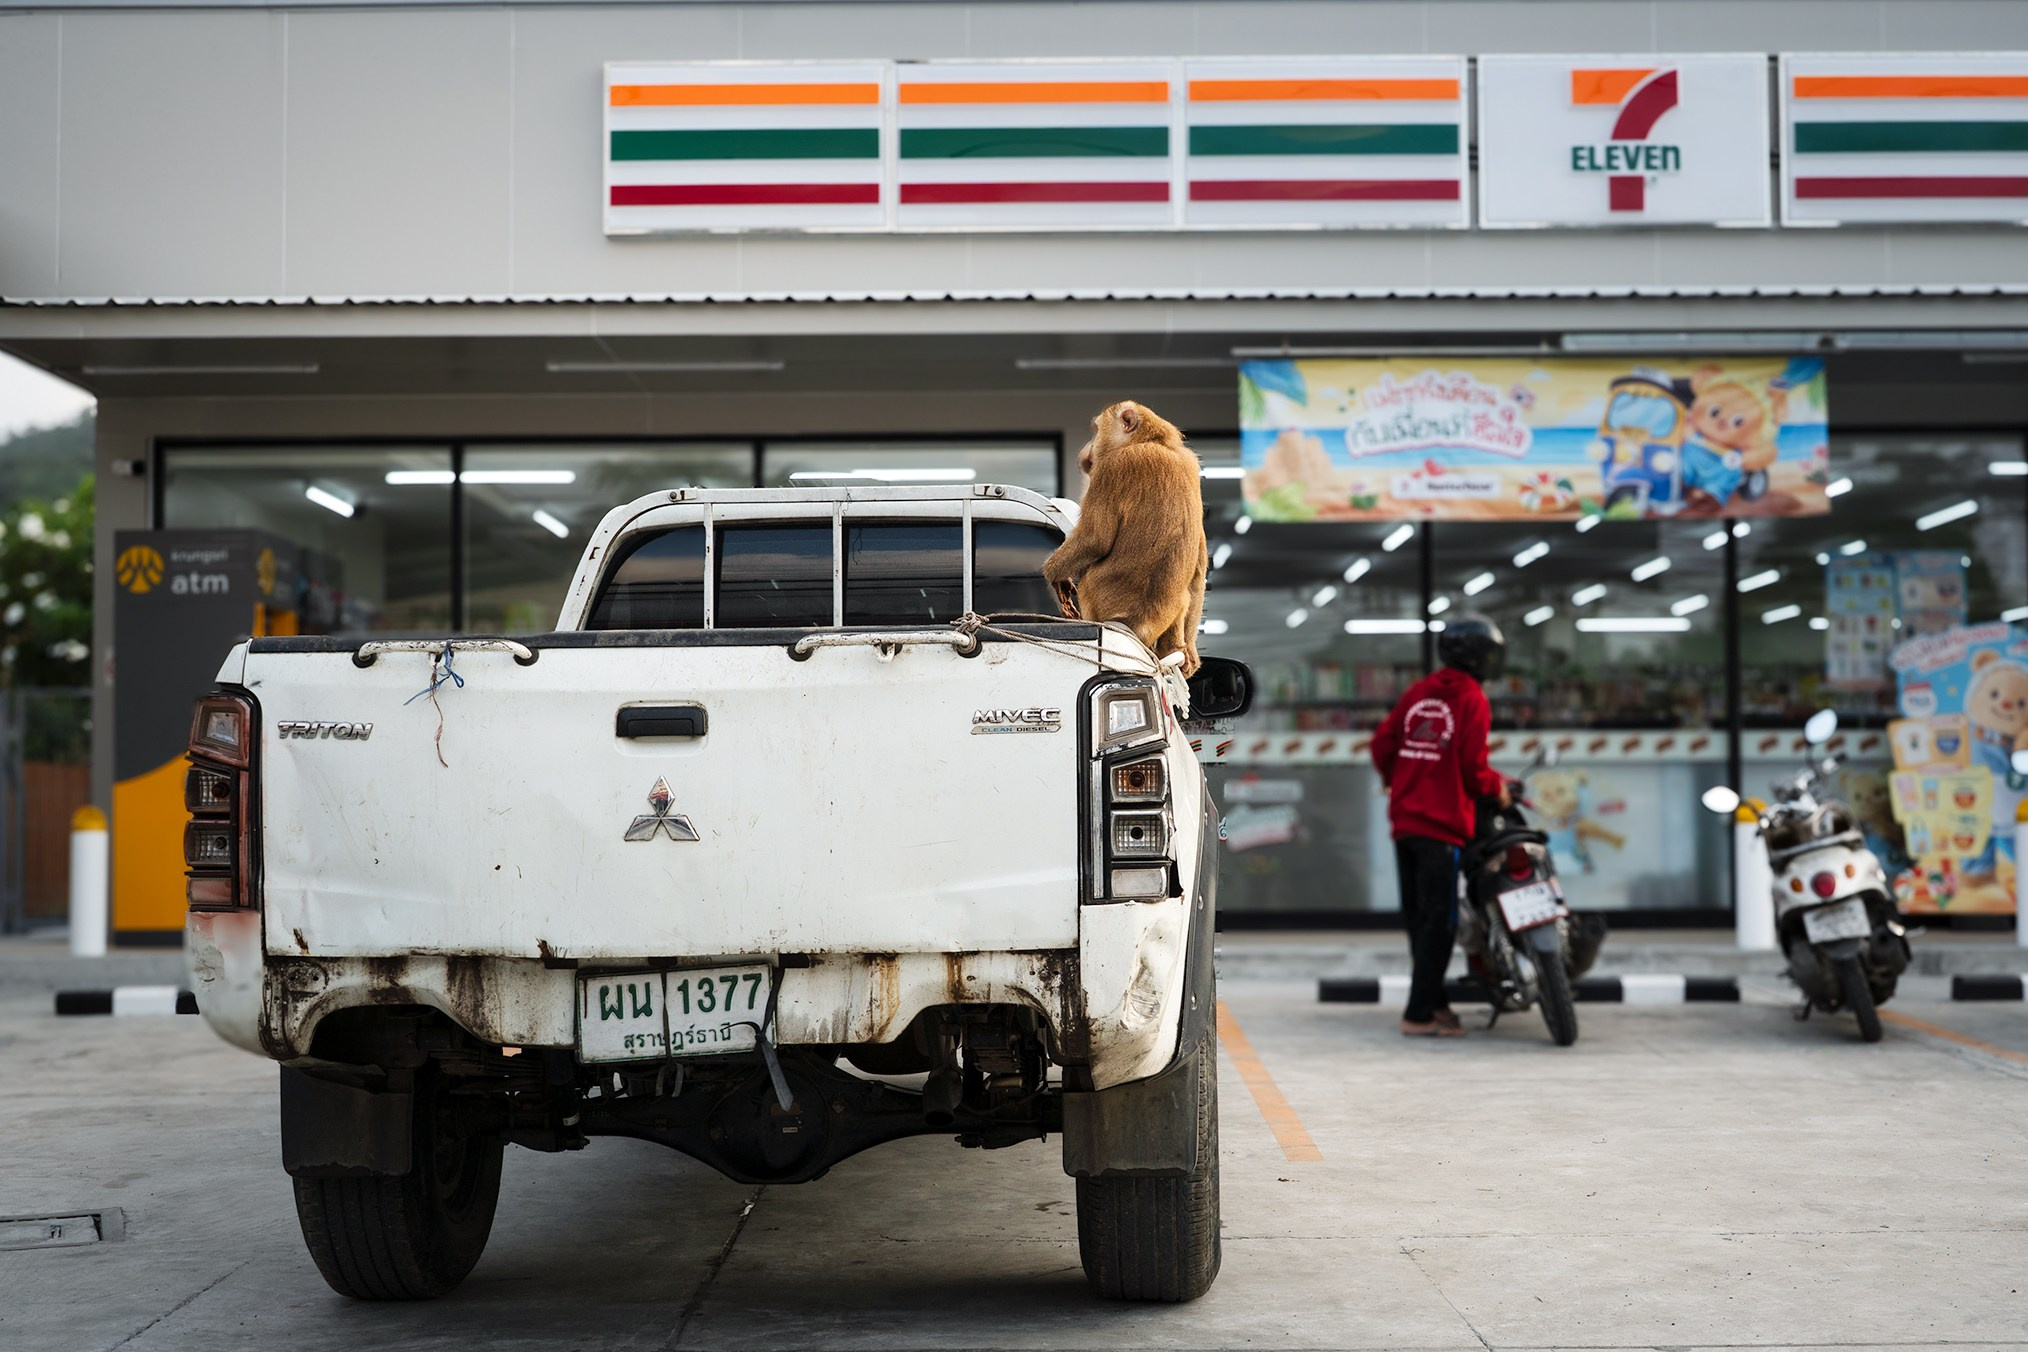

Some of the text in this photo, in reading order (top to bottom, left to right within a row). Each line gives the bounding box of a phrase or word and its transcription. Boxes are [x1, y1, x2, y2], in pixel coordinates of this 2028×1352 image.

[1571, 69, 1678, 211] 7
[171, 571, 230, 595] atm
[972, 708, 1061, 724] MIVEC
[277, 720, 374, 741] TRITON
[1016, 725, 1052, 733] DIESEL
[599, 972, 763, 1021] ผน 1377
